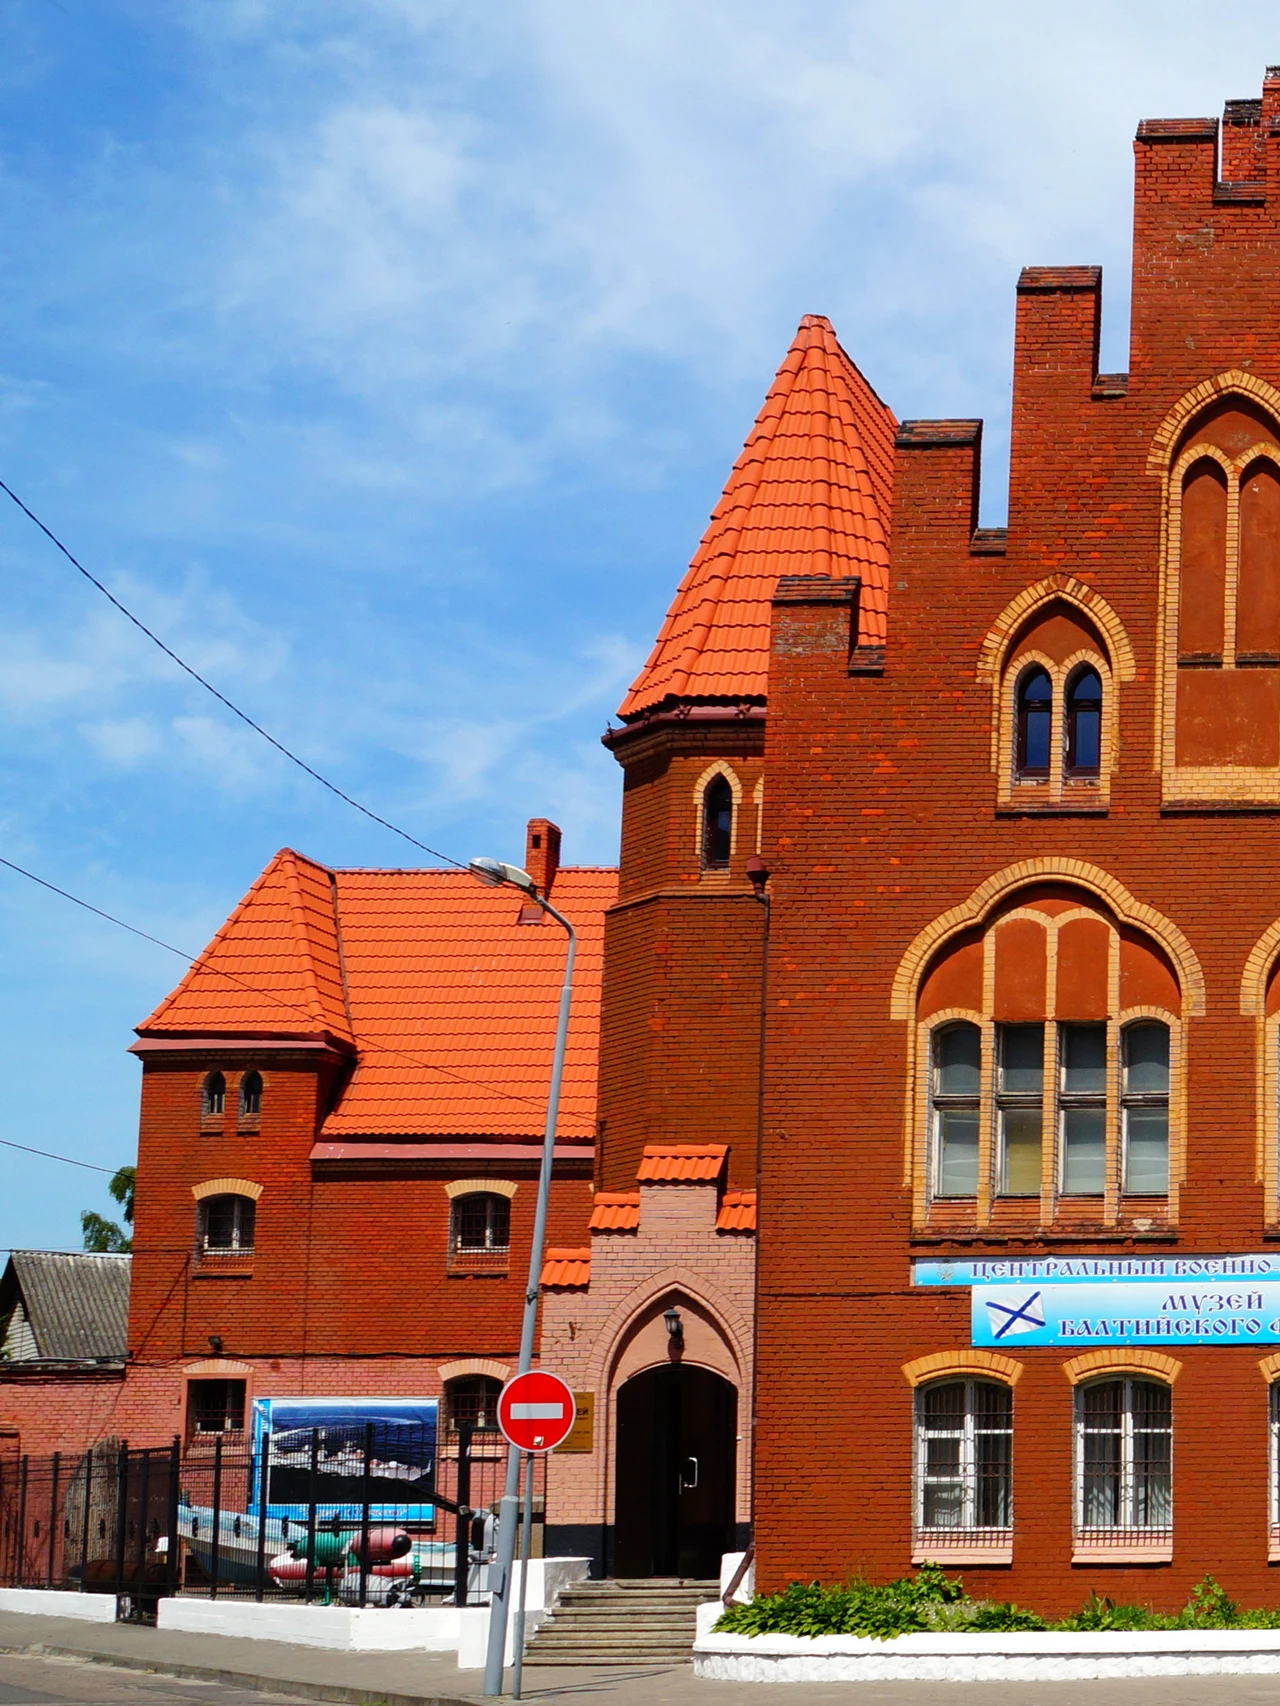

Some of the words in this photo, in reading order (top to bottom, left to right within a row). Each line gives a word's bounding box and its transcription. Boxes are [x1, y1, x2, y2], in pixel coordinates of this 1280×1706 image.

[971, 1257, 1166, 1280] ЦЕНТРАЛЬНЫЙ
[1161, 1290, 1264, 1314] МУЗЕЙ
[1059, 1315, 1261, 1336] БАЛТИЙСКОГО
